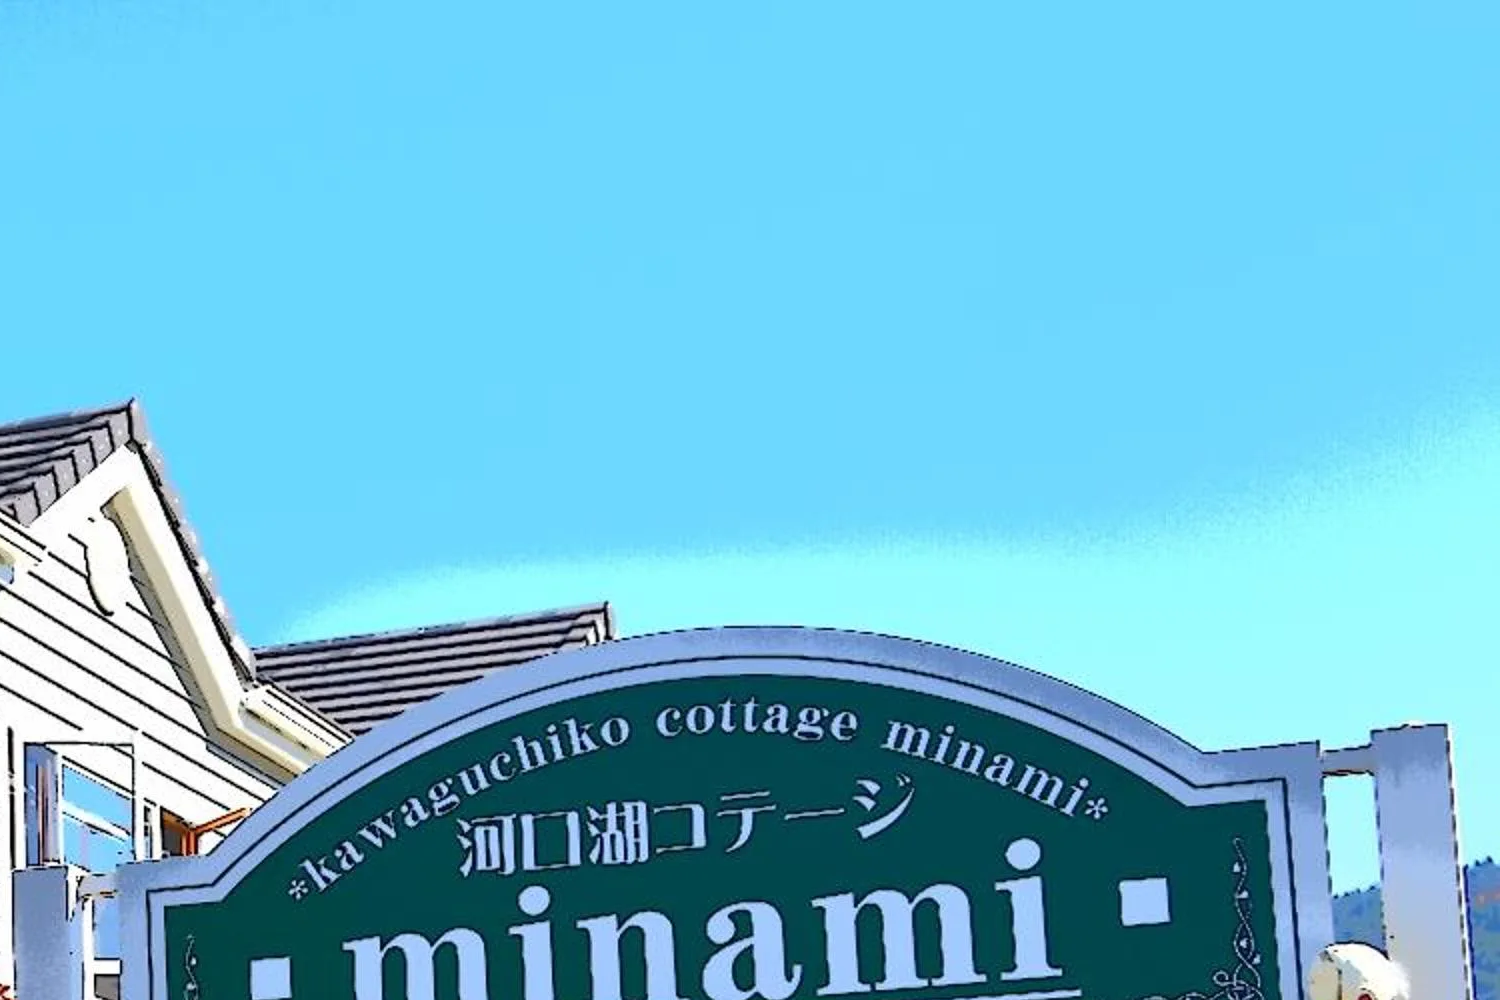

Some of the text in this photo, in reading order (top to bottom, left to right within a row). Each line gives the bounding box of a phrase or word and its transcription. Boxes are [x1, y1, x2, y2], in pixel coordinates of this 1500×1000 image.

[301, 697, 1084, 892] kawaguchiko cottage minami
[456, 772, 915, 878] 河口湖コテージ
